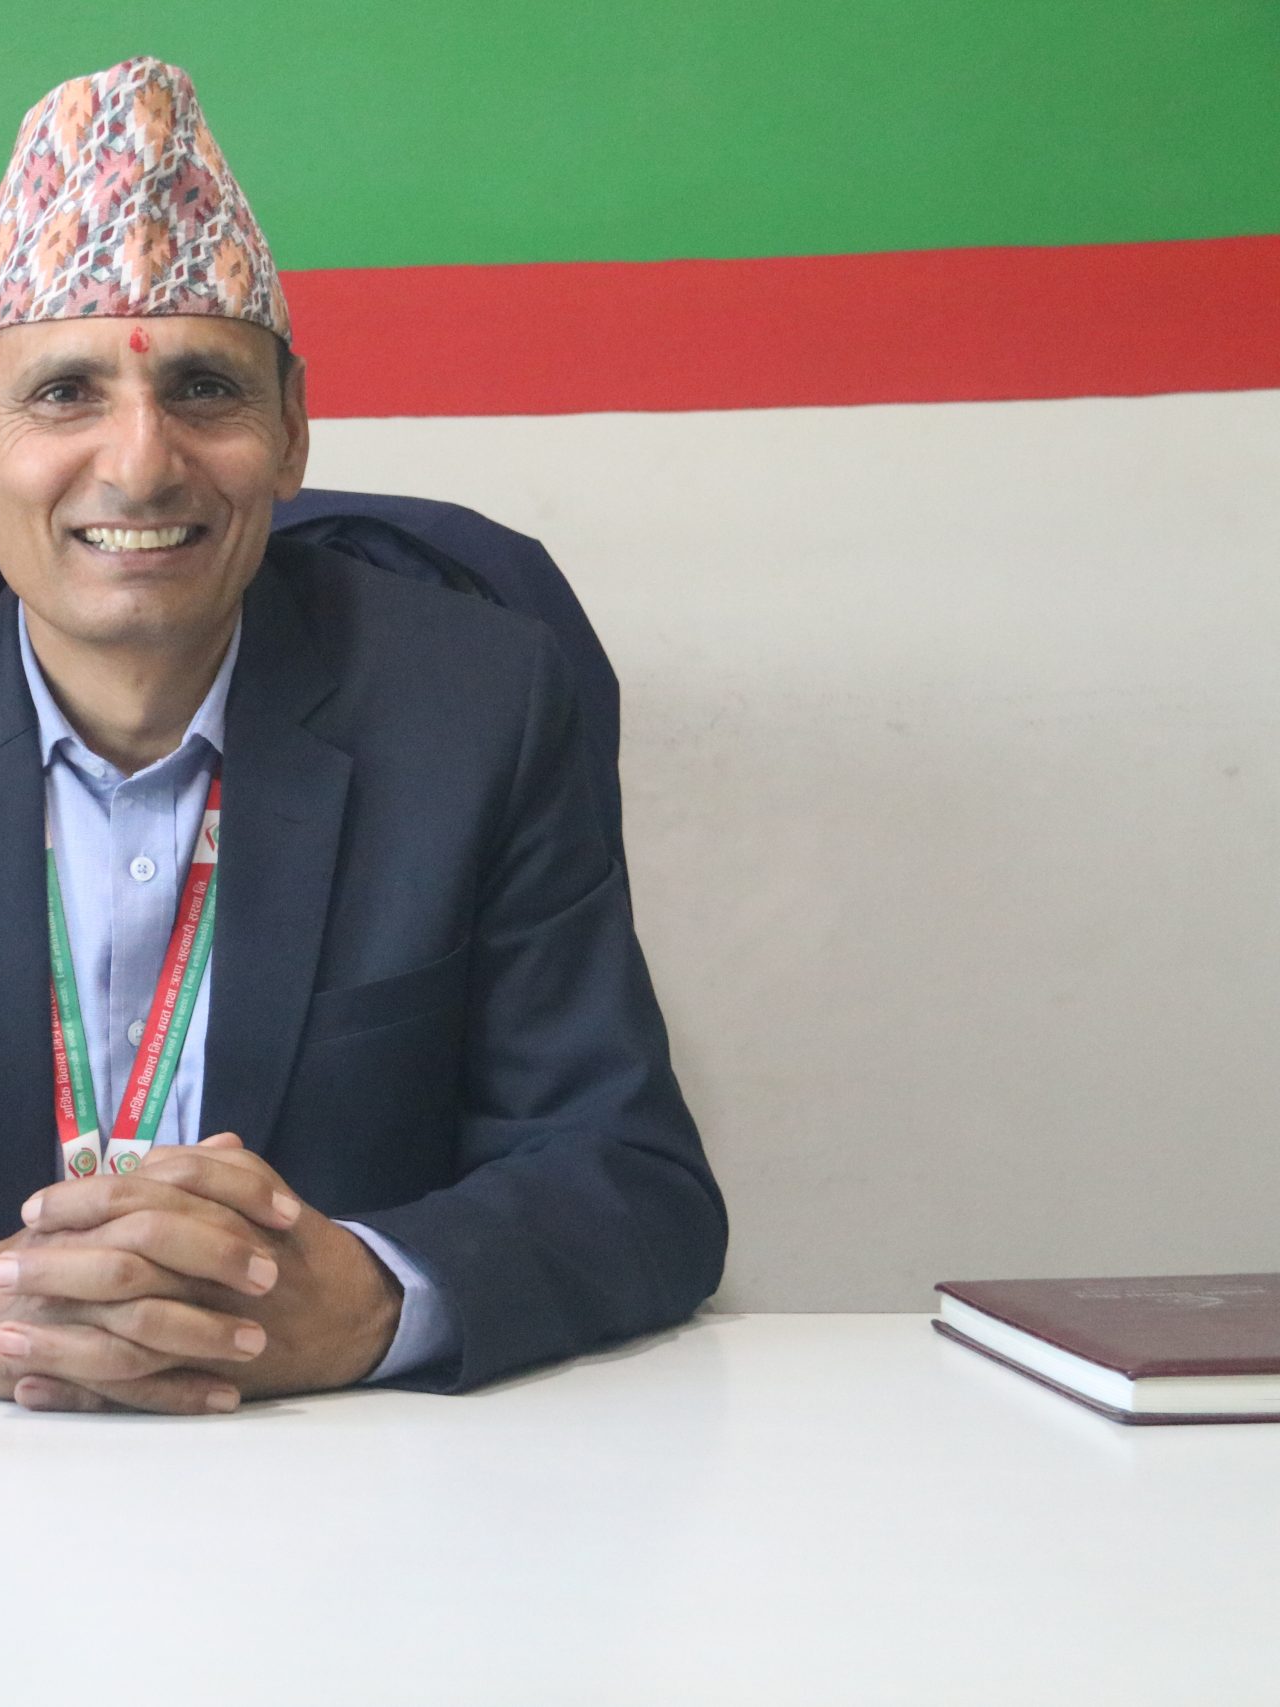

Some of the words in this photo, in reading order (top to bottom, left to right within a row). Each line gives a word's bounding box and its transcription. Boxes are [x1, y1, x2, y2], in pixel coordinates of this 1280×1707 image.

[129, 1088, 147, 1122] आर्थिक
[138, 1055, 157, 1087] विकास
[148, 1033, 165, 1054] मित्र
[165, 988, 178, 1008] तथा
[177, 924, 196, 962] सहकारी
[56, 1052, 69, 1085] विकास
[60, 1086, 75, 1121] आर्थिक
